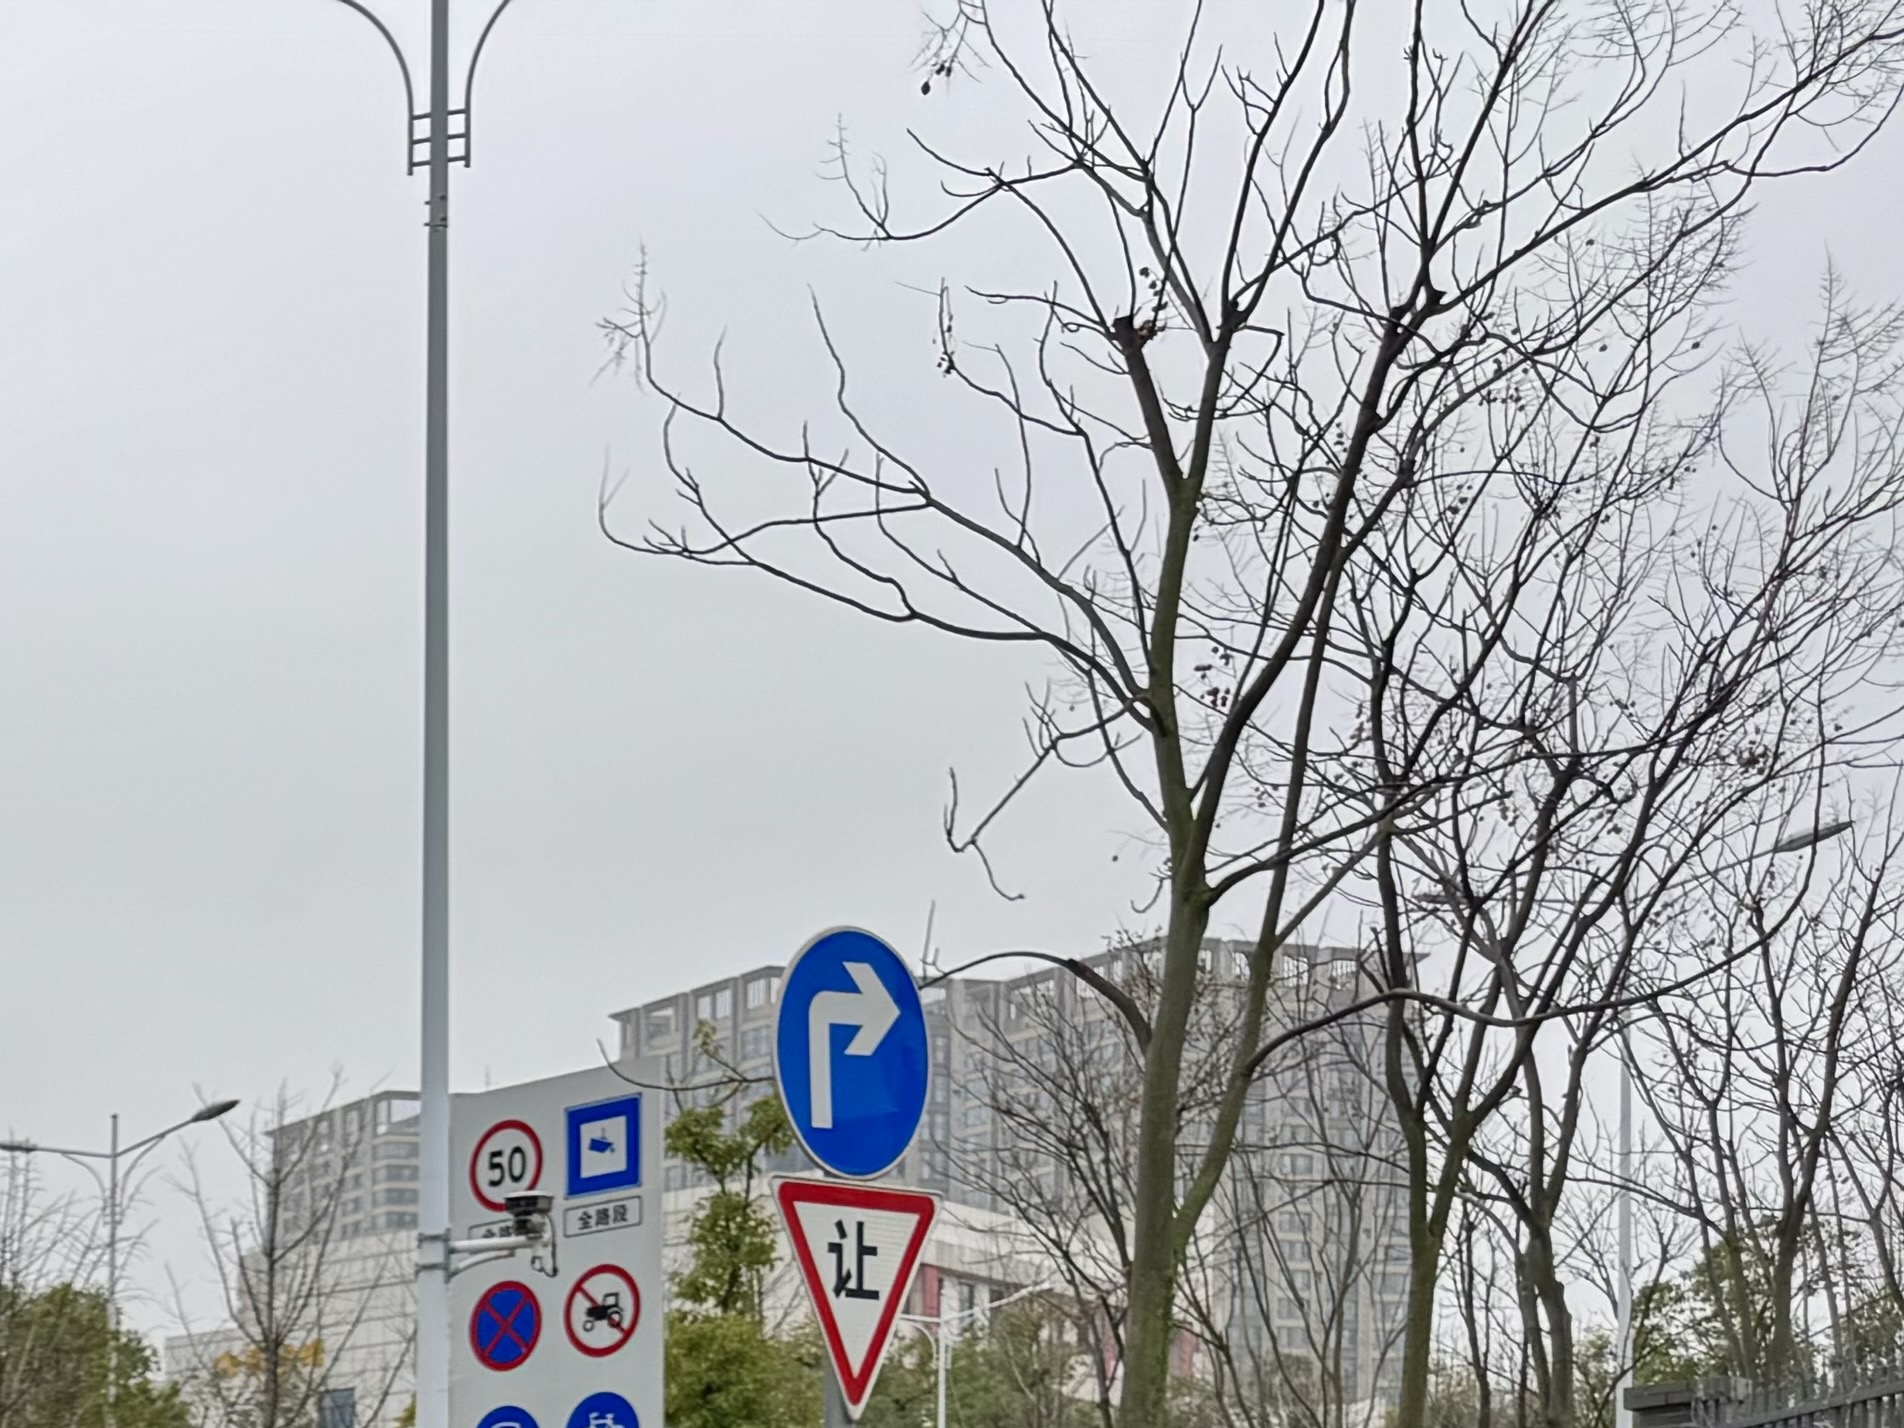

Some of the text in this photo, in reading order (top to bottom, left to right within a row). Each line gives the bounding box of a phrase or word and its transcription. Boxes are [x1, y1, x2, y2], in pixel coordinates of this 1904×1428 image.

[487, 1145, 527, 1187] 50
[577, 1204, 628, 1230] 全路段
[826, 1219, 880, 1301] 让
